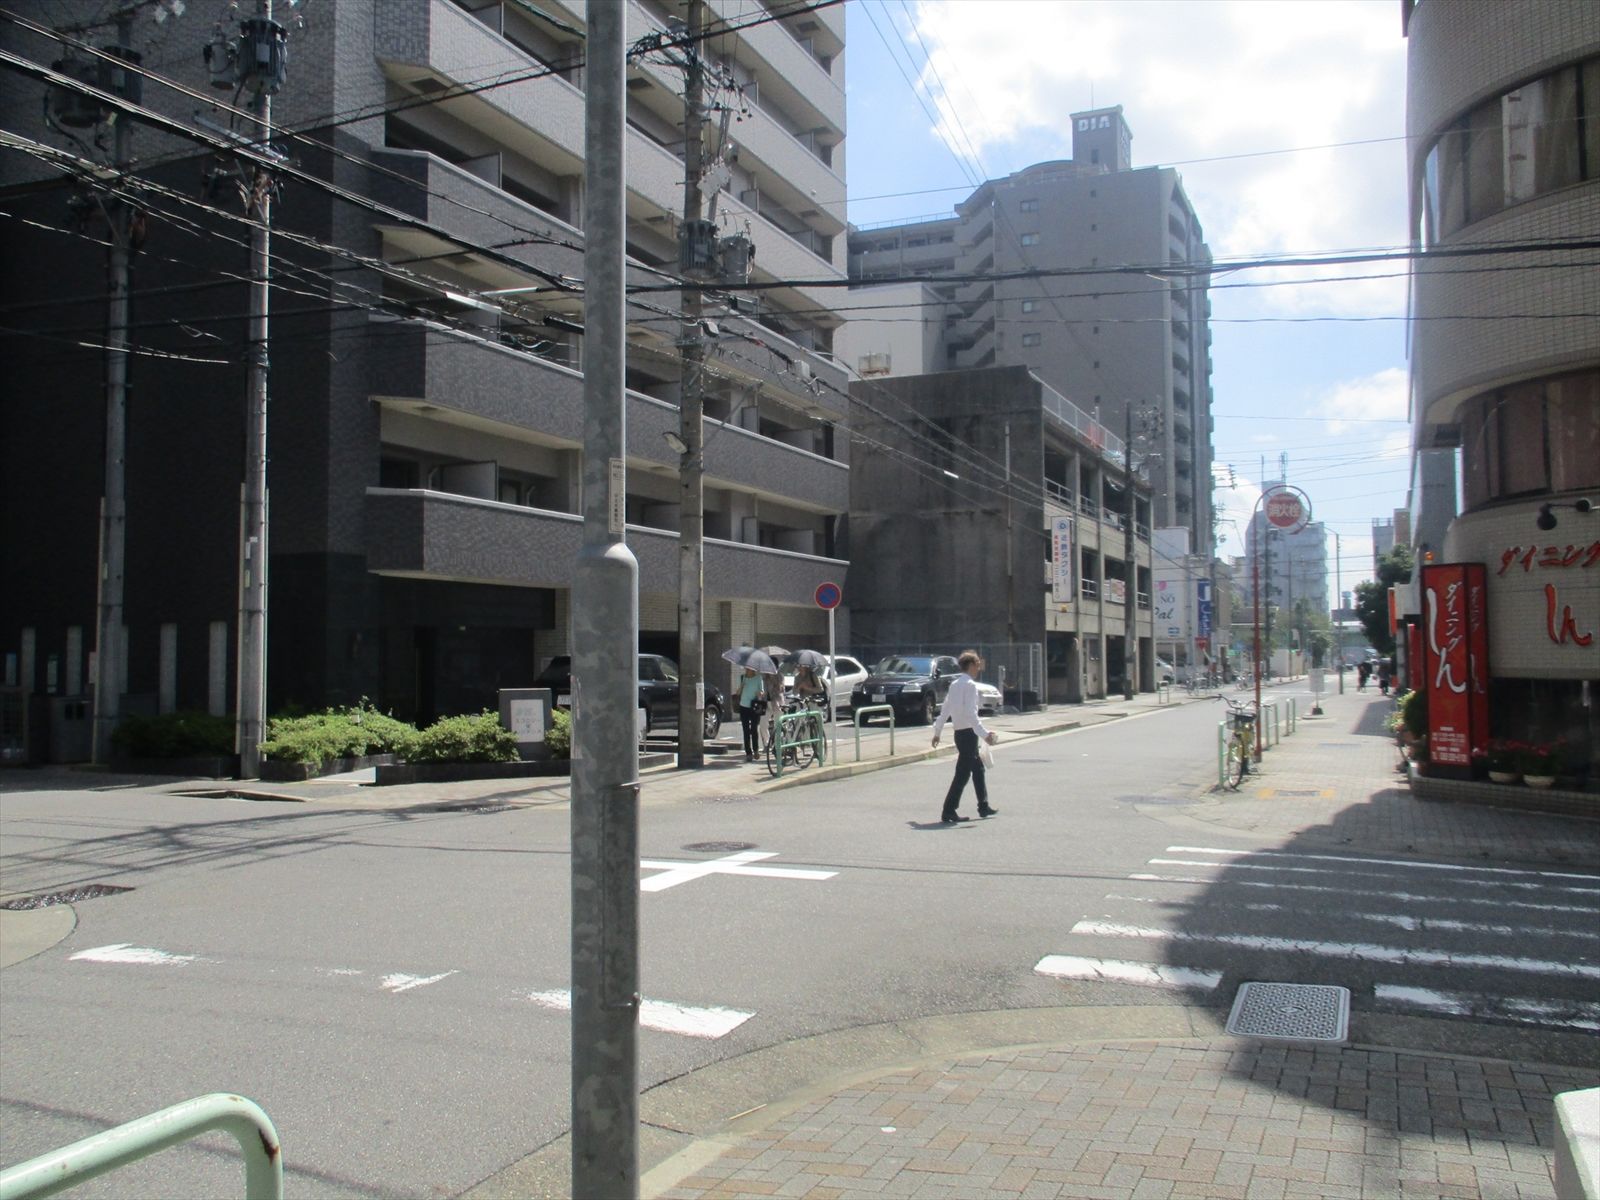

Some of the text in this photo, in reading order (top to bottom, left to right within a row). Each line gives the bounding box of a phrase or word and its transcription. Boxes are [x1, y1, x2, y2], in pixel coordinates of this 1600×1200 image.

[1078, 115, 1111, 132] DIA
[1268, 503, 1301, 518] 消火栓
[1426, 587, 1467, 694] しん
[1445, 581, 1463, 652] ダイニング
[1543, 583, 1594, 647] しん
